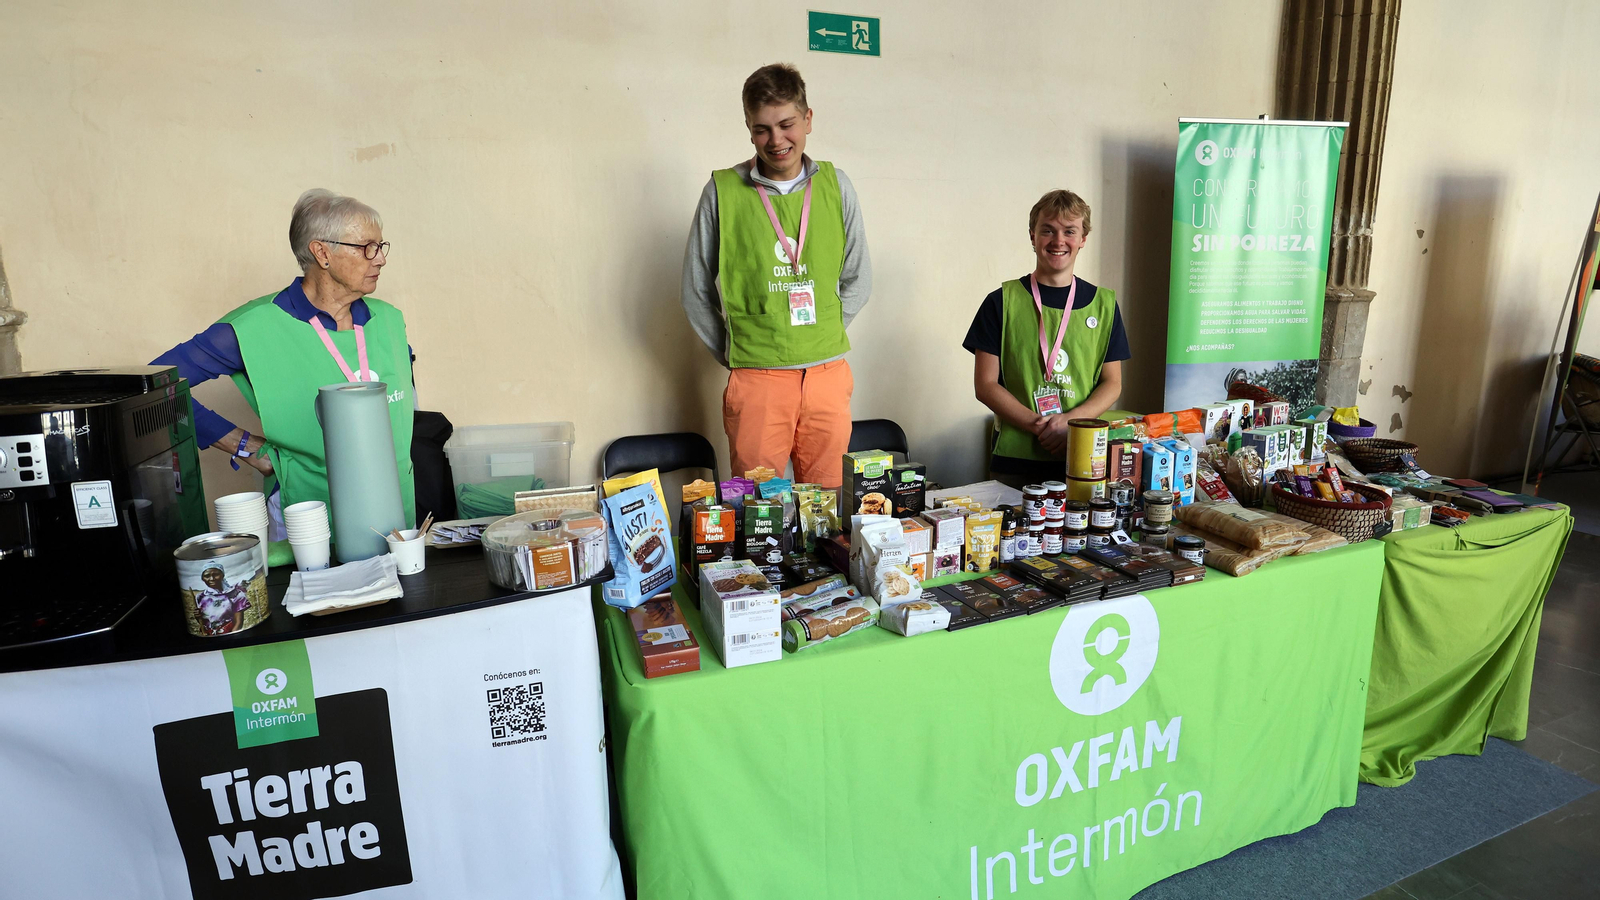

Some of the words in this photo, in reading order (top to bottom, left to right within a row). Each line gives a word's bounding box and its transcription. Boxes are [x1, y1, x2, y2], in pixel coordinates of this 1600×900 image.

[1192, 203, 1222, 229] UN
[1191, 234, 1224, 252] SIN
[1230, 234, 1316, 252] POBREZA
[1186, 344, 1200, 352] ¿NOS
[1201, 342, 1235, 351] ACOMPAÑAS?
[88, 495, 101, 508] A
[484, 670, 527, 681] Conócenos
[251, 697, 298, 715] OXFAM
[246, 710, 306, 730] Intermón
[492, 734, 548, 748] tierramadre.org
[1015, 716, 1182, 807] OXFAM
[201, 760, 367, 825] Tierra
[208, 821, 381, 880] Madre
[970, 782, 1203, 900] Intermón
